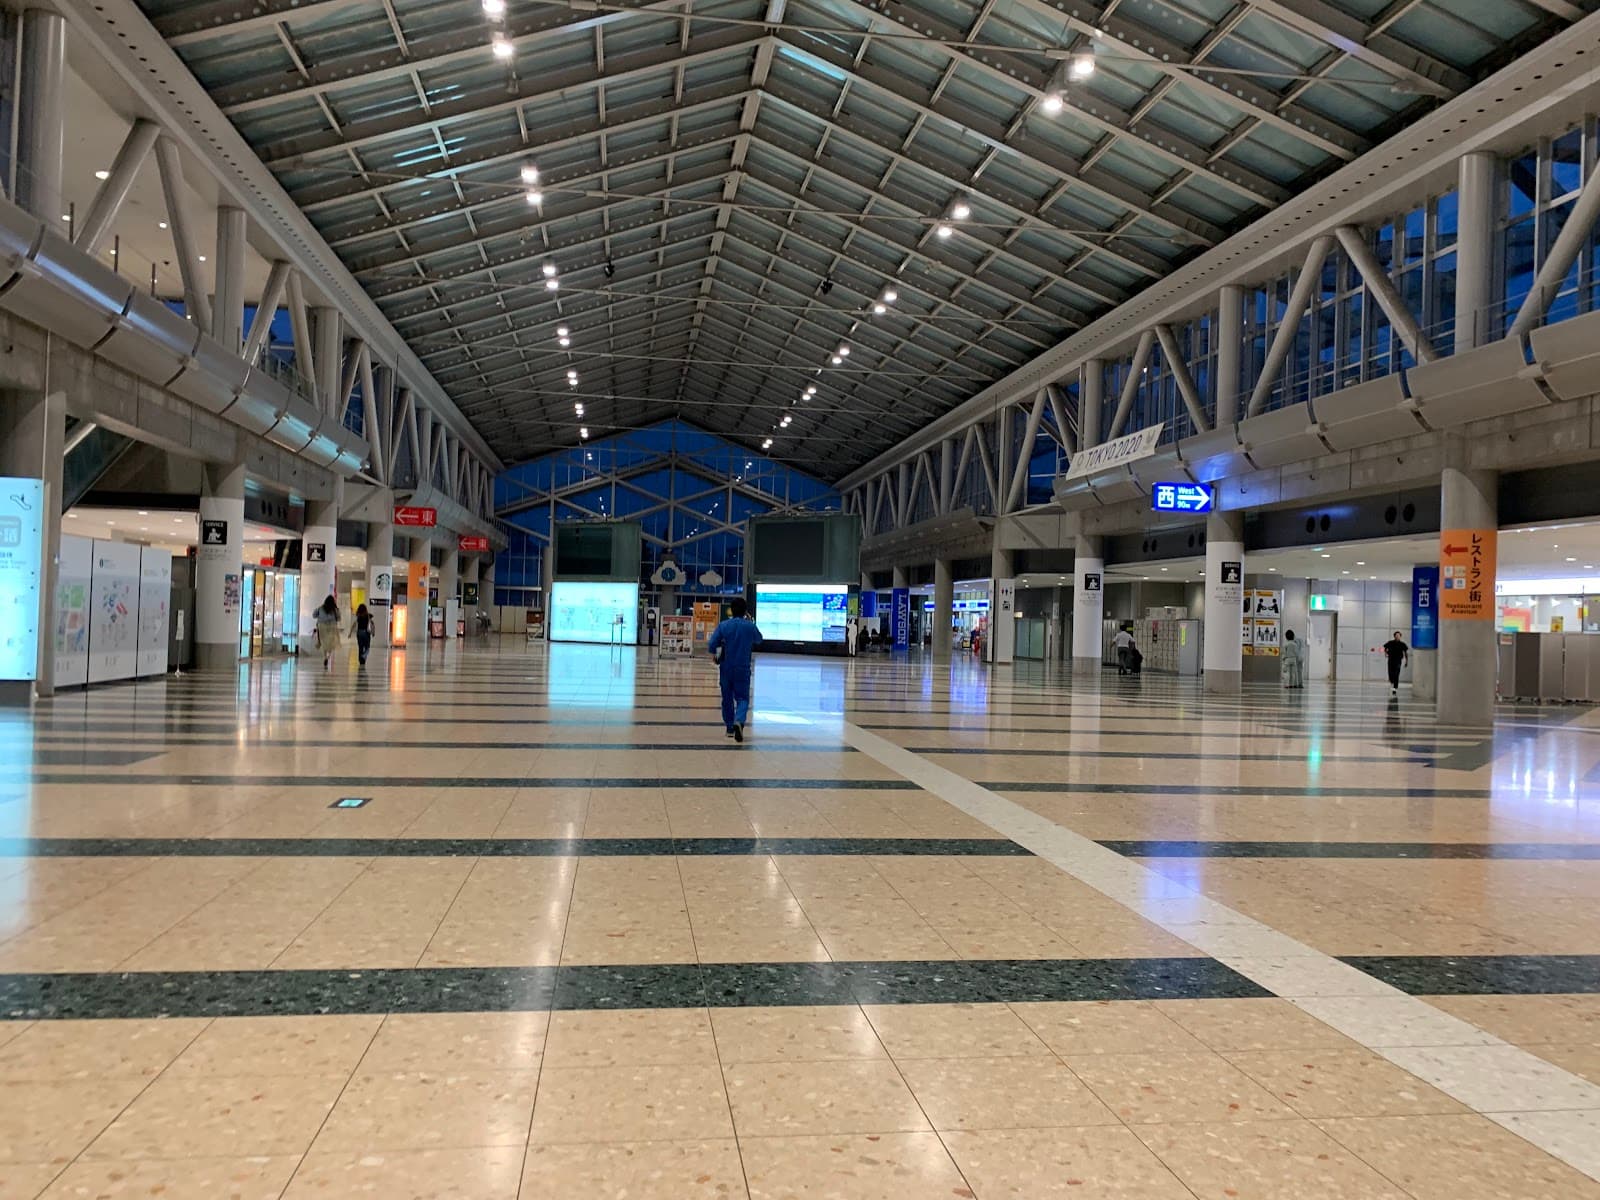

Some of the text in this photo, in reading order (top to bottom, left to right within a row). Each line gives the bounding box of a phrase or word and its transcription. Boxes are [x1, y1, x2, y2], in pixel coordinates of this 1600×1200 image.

[1085, 434, 1143, 468] TOKYO 2020
[1157, 485, 1175, 508] 西
[1177, 486, 1195, 495] West
[1177, 500, 1191, 509] 90m
[422, 510, 433, 525] 東
[1469, 533, 1482, 602] レストラン街
[1418, 587, 1430, 607] 西
[897, 594, 908, 645] LAWSON
